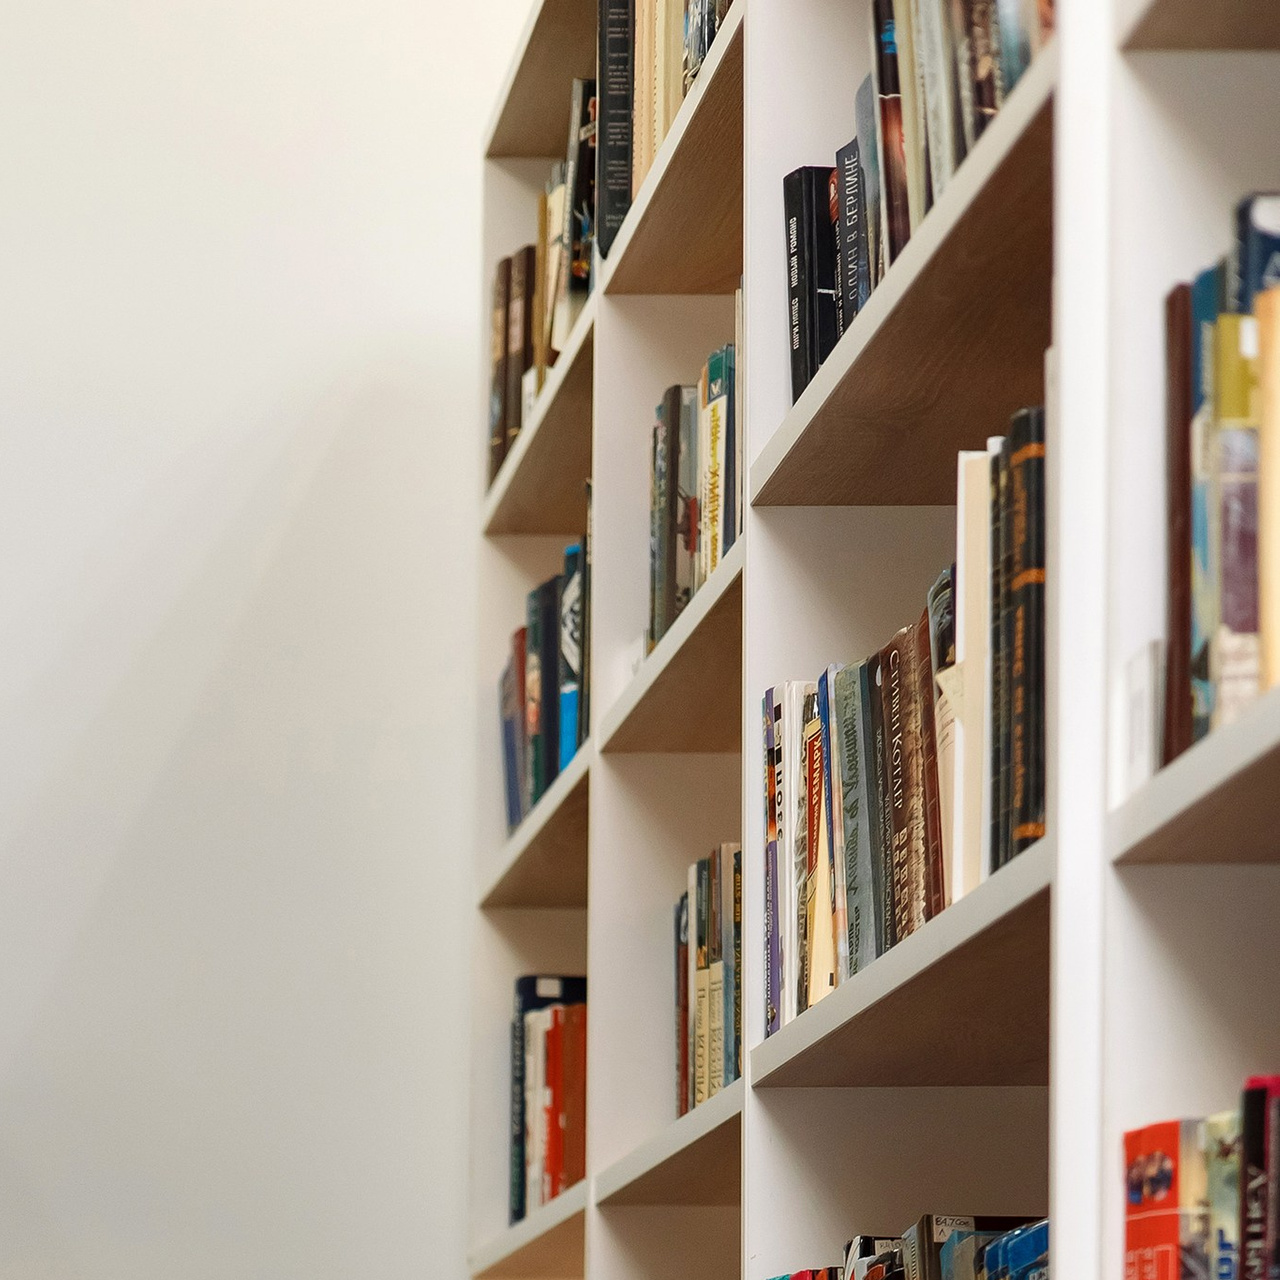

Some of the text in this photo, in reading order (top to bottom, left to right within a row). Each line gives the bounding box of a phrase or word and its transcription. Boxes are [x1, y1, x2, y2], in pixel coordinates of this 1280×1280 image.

[789, 216, 799, 288] НОВЫЙ РОМАНС
[844, 150, 859, 300] ОДИН В БЕРЛИНЕ
[792, 326, 800, 350] АНРИ
[776, 768, 784, 841] ЭЗОП
[811, 737, 822, 806] РЕМАРК
